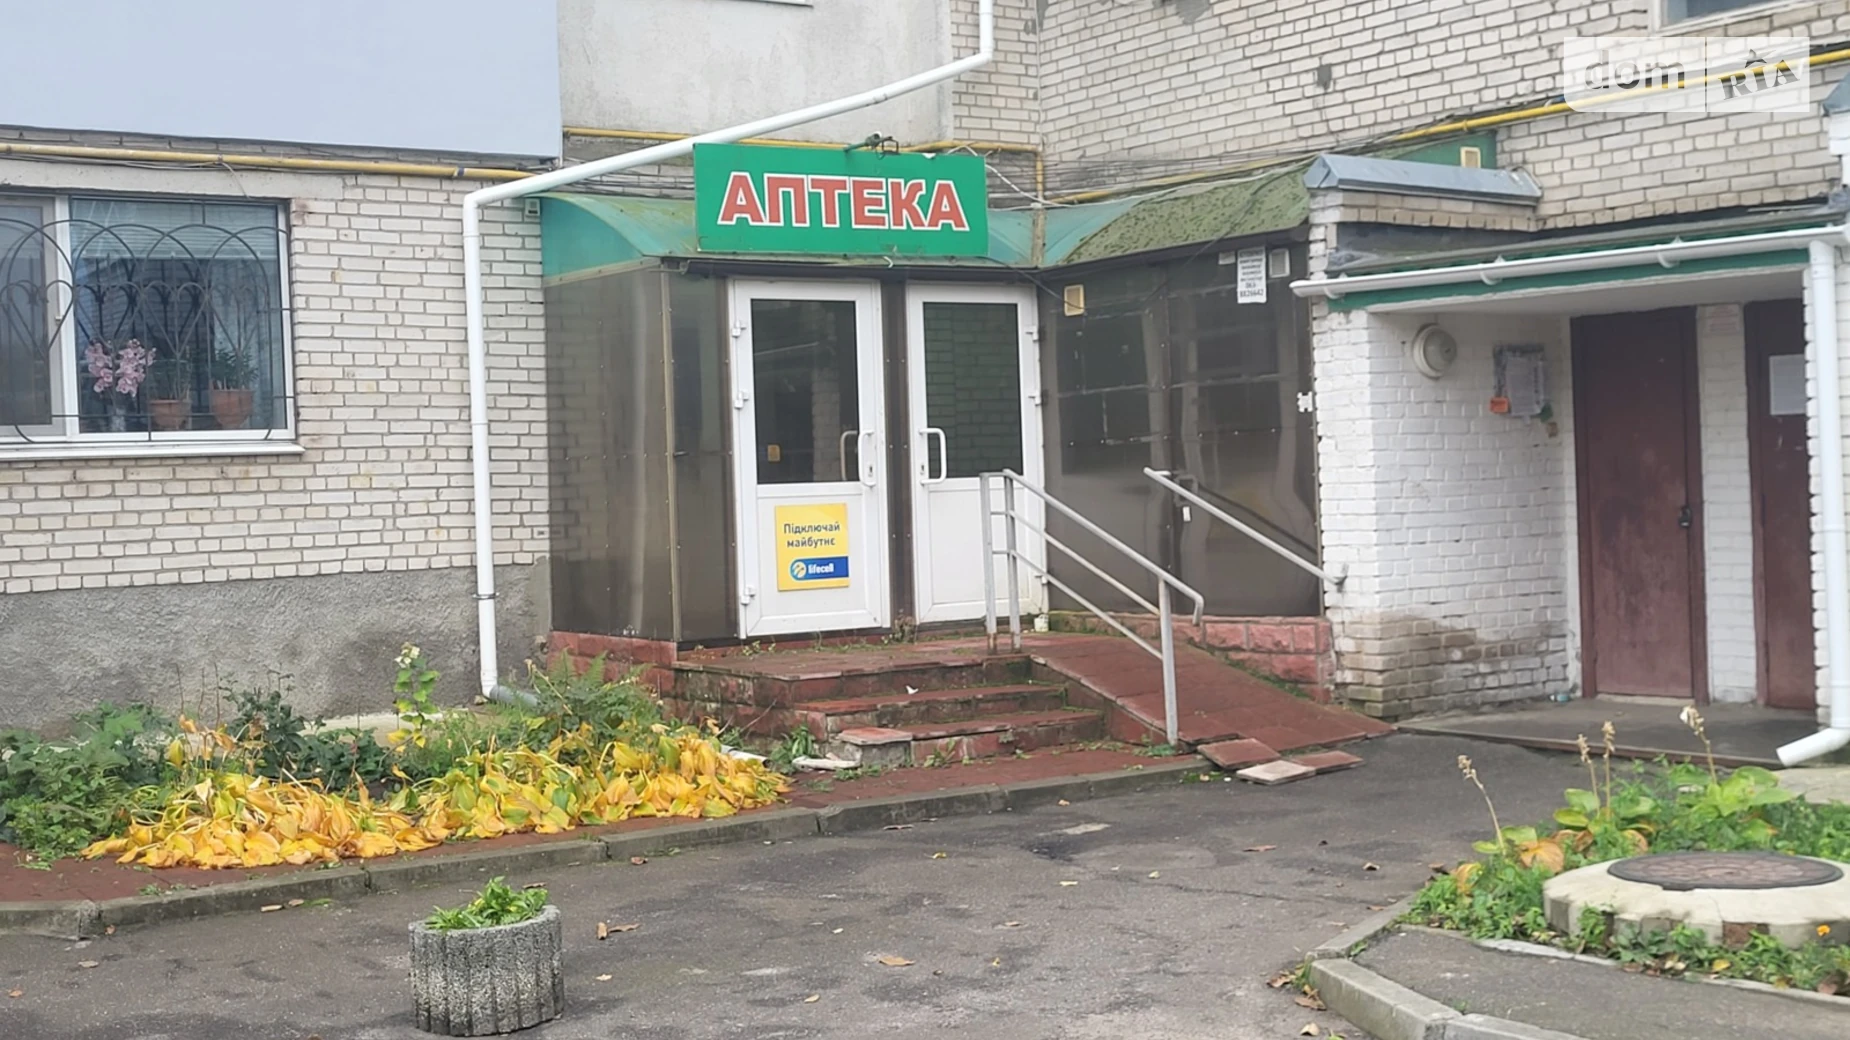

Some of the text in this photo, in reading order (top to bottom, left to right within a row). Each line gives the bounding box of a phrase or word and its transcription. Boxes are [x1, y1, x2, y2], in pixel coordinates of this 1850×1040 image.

[717, 171, 970, 231] АПТЕКА
[783, 521, 840, 534] Підключай
[787, 536, 836, 548] майбутнє
[808, 563, 834, 574] lifecell
